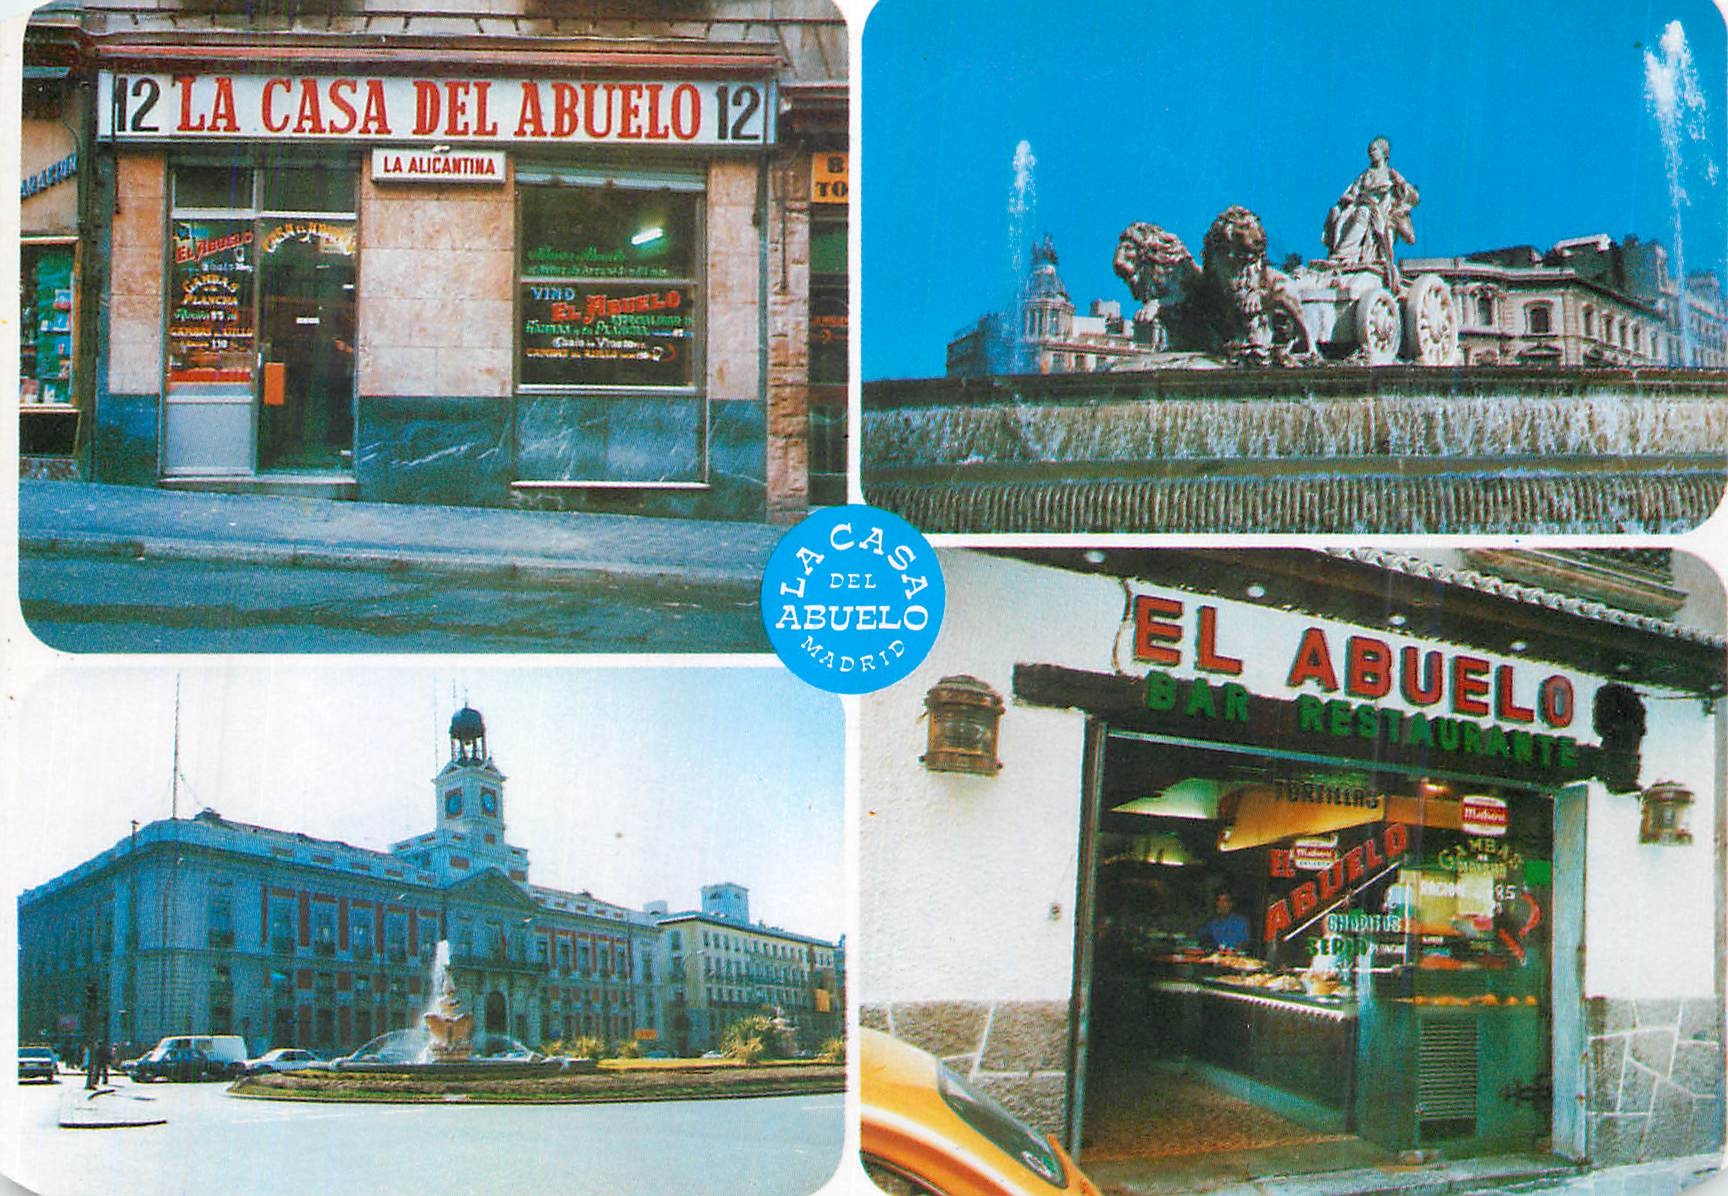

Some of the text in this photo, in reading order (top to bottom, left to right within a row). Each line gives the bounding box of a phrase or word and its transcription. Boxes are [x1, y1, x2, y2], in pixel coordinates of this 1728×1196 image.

[115, 77, 761, 141] 12 LA CASA DEL ABUELO 12
[383, 155, 496, 175] LA ALICANTINA
[176, 229, 254, 265] EL ABUELO
[531, 286, 575, 300] VINO
[551, 290, 681, 324] EL ABUELO
[1134, 595, 1575, 729] EL ABUELO
[1145, 669, 1579, 769] BAR RESTAURANTE
[1264, 822, 1408, 942] ABUELO
